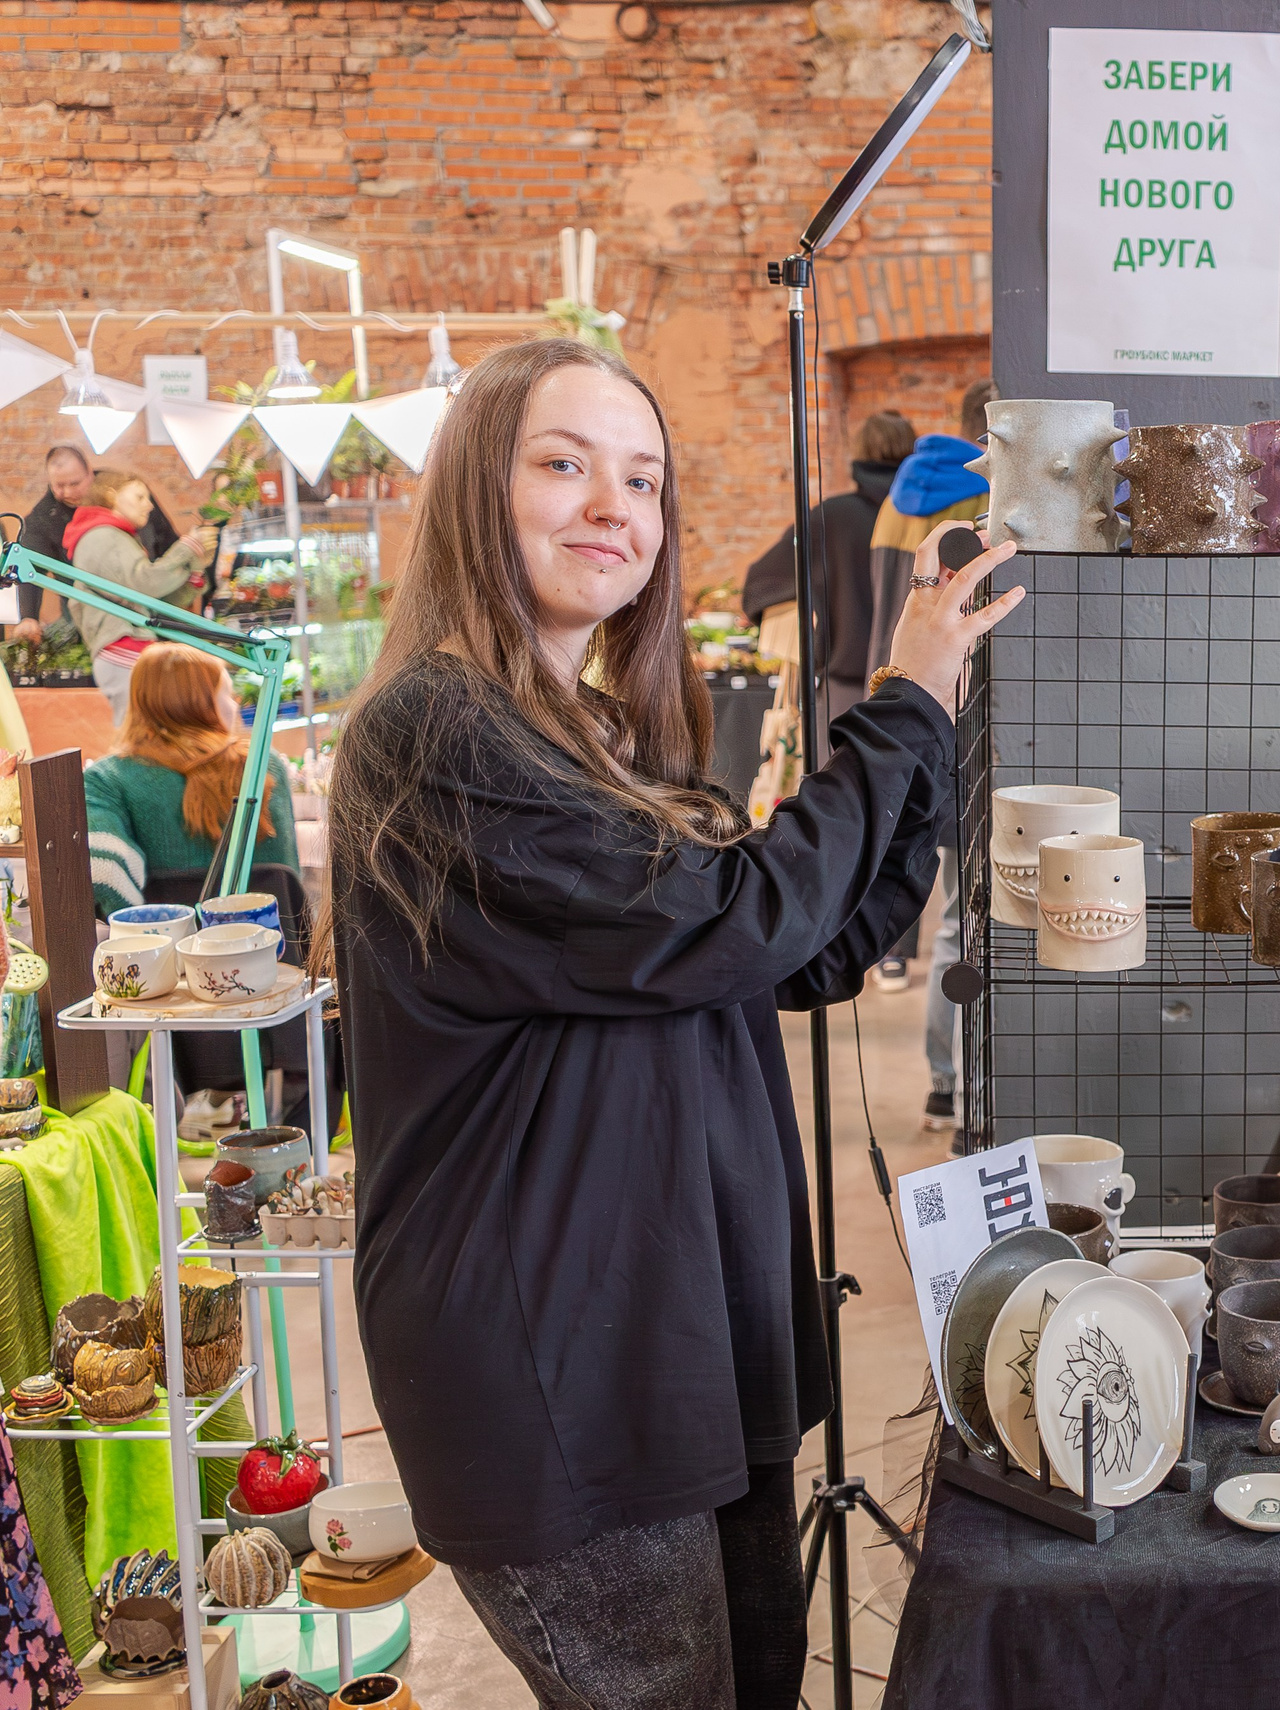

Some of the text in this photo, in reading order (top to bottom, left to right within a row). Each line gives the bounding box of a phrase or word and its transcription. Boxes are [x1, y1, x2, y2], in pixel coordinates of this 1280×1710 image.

[1104, 59, 1232, 92] ЗАБЕРИ
[1104, 113, 1228, 155] ДОМОЙ
[1100, 178, 1234, 210] НОВОГО
[1112, 237, 1217, 273] ДРУГА
[1114, 348, 1214, 362] ГРОУБОКС МАРКЕТ
